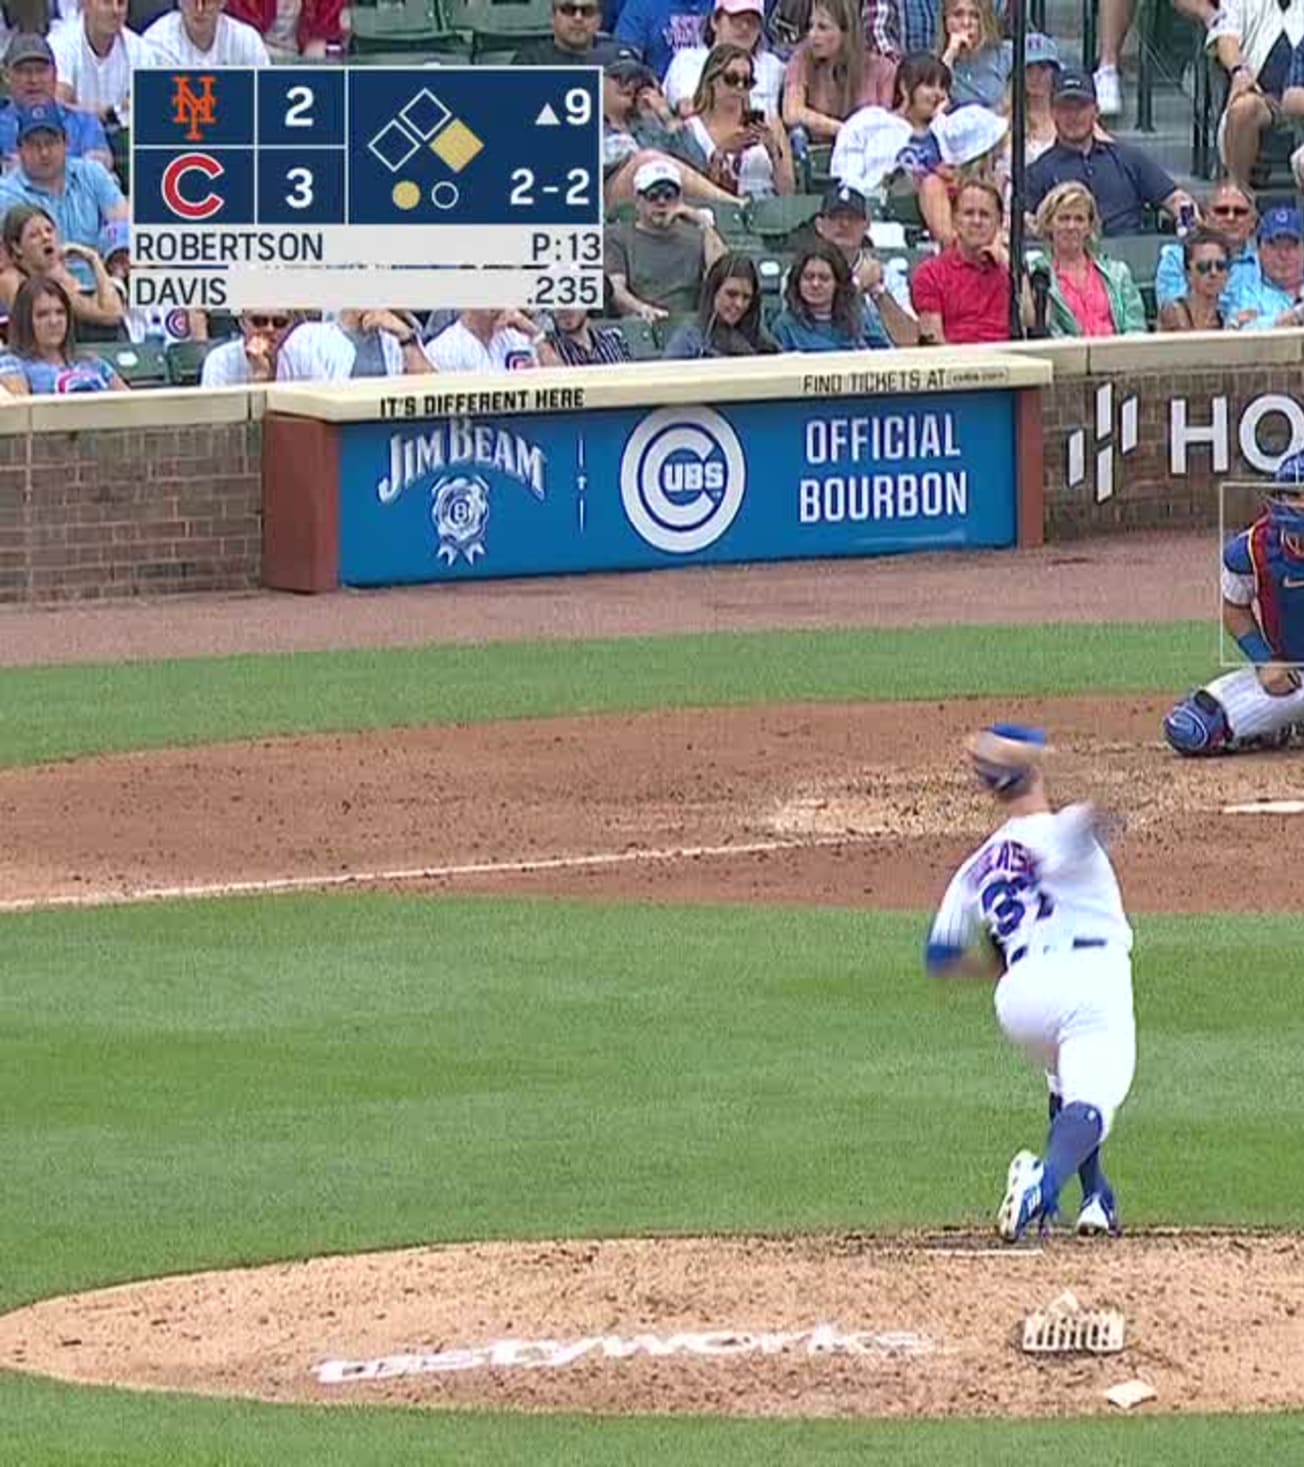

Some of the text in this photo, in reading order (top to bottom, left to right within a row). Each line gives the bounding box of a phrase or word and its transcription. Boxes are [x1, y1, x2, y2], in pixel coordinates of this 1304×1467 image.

[380, 387, 585, 417] IT'S DIFFERENT HERE
[803, 374, 843, 393] FIND
[850, 370, 921, 392] TICKETS
[926, 369, 946, 388] AT
[378, 418, 548, 503] JIM BEAM
[806, 413, 961, 464] OFFICIAL
[800, 471, 967, 522] BOURBON
